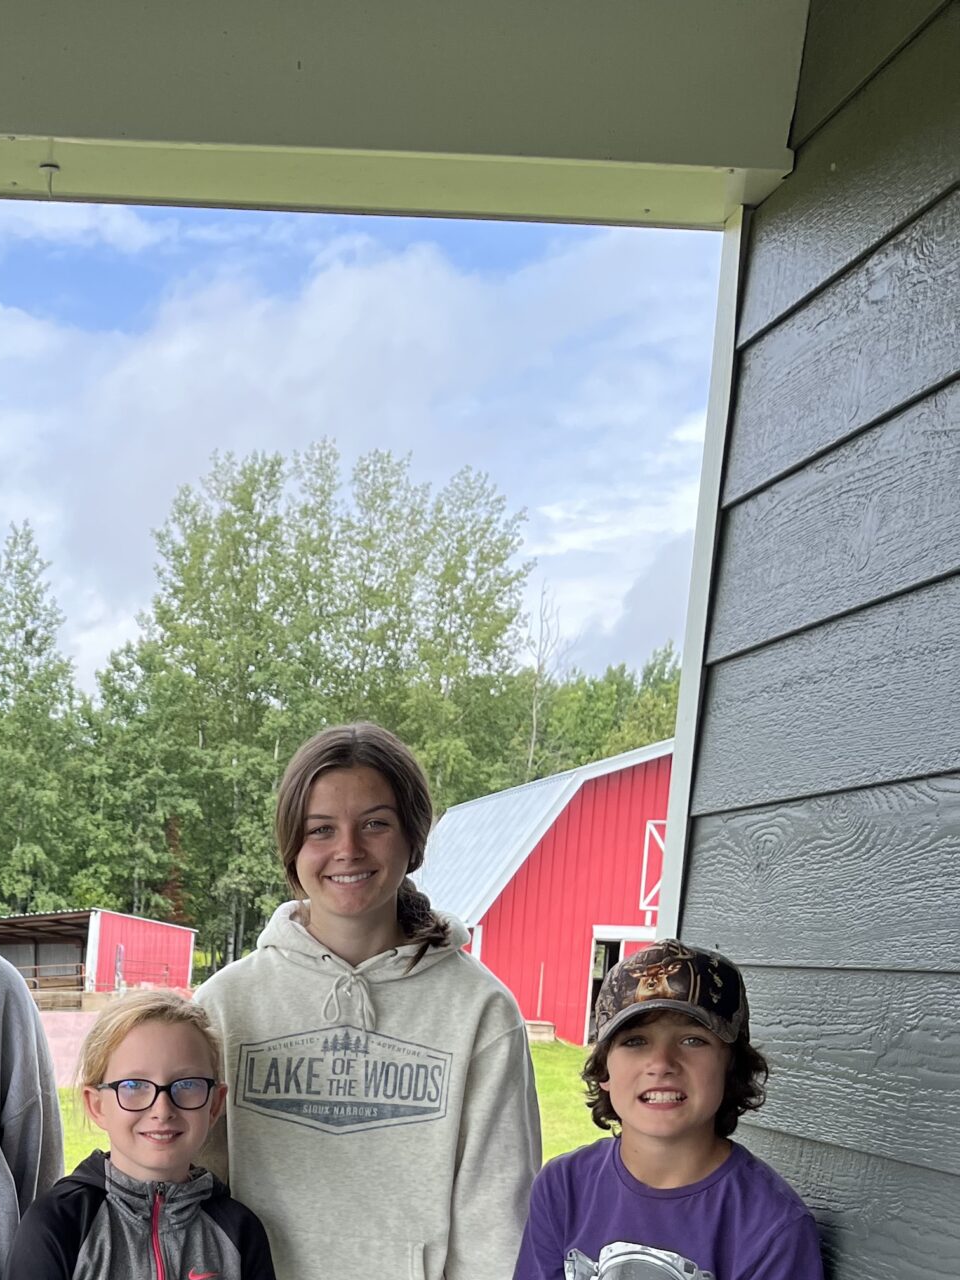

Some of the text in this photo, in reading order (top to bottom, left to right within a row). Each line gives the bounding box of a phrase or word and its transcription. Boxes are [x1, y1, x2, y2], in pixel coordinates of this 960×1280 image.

[267, 1037, 421, 1057] AUTHENTIC ADVENTURE
[248, 1057, 442, 1103] LAKE OF THE WOODS
[302, 1105, 378, 1117] SIOUX NARROWS
